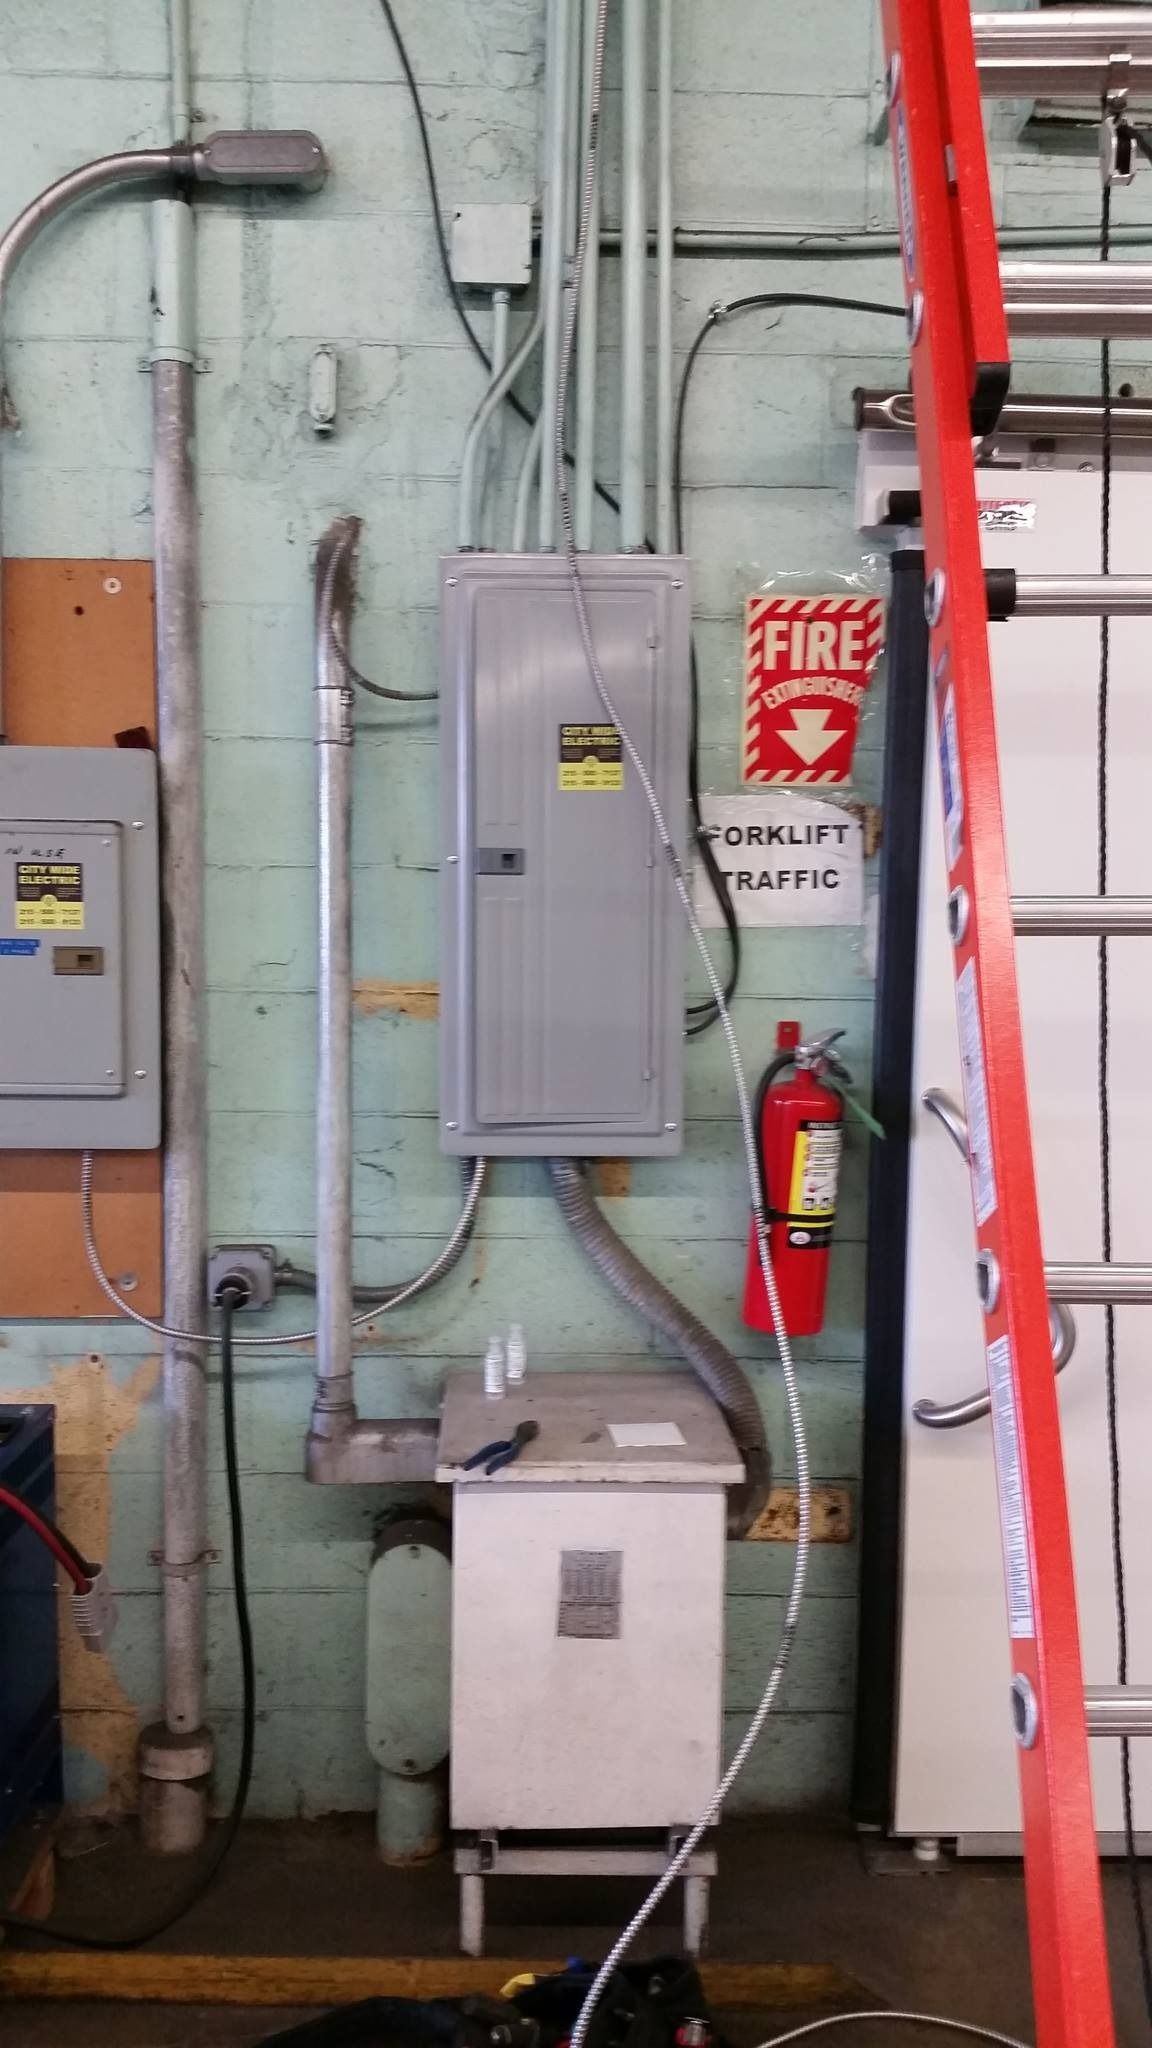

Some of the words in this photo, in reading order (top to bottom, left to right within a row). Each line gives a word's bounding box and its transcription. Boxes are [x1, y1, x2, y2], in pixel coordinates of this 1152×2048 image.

[763, 620, 866, 671] FIRE
[760, 676, 865, 709] EXTINGUISHER
[561, 726, 589, 736] CITY
[561, 737, 622, 746] ELECTRIC
[18, 865, 47, 874] CITY
[49, 865, 81, 875] WIDE
[18, 875, 81, 885] ELECTRIC
